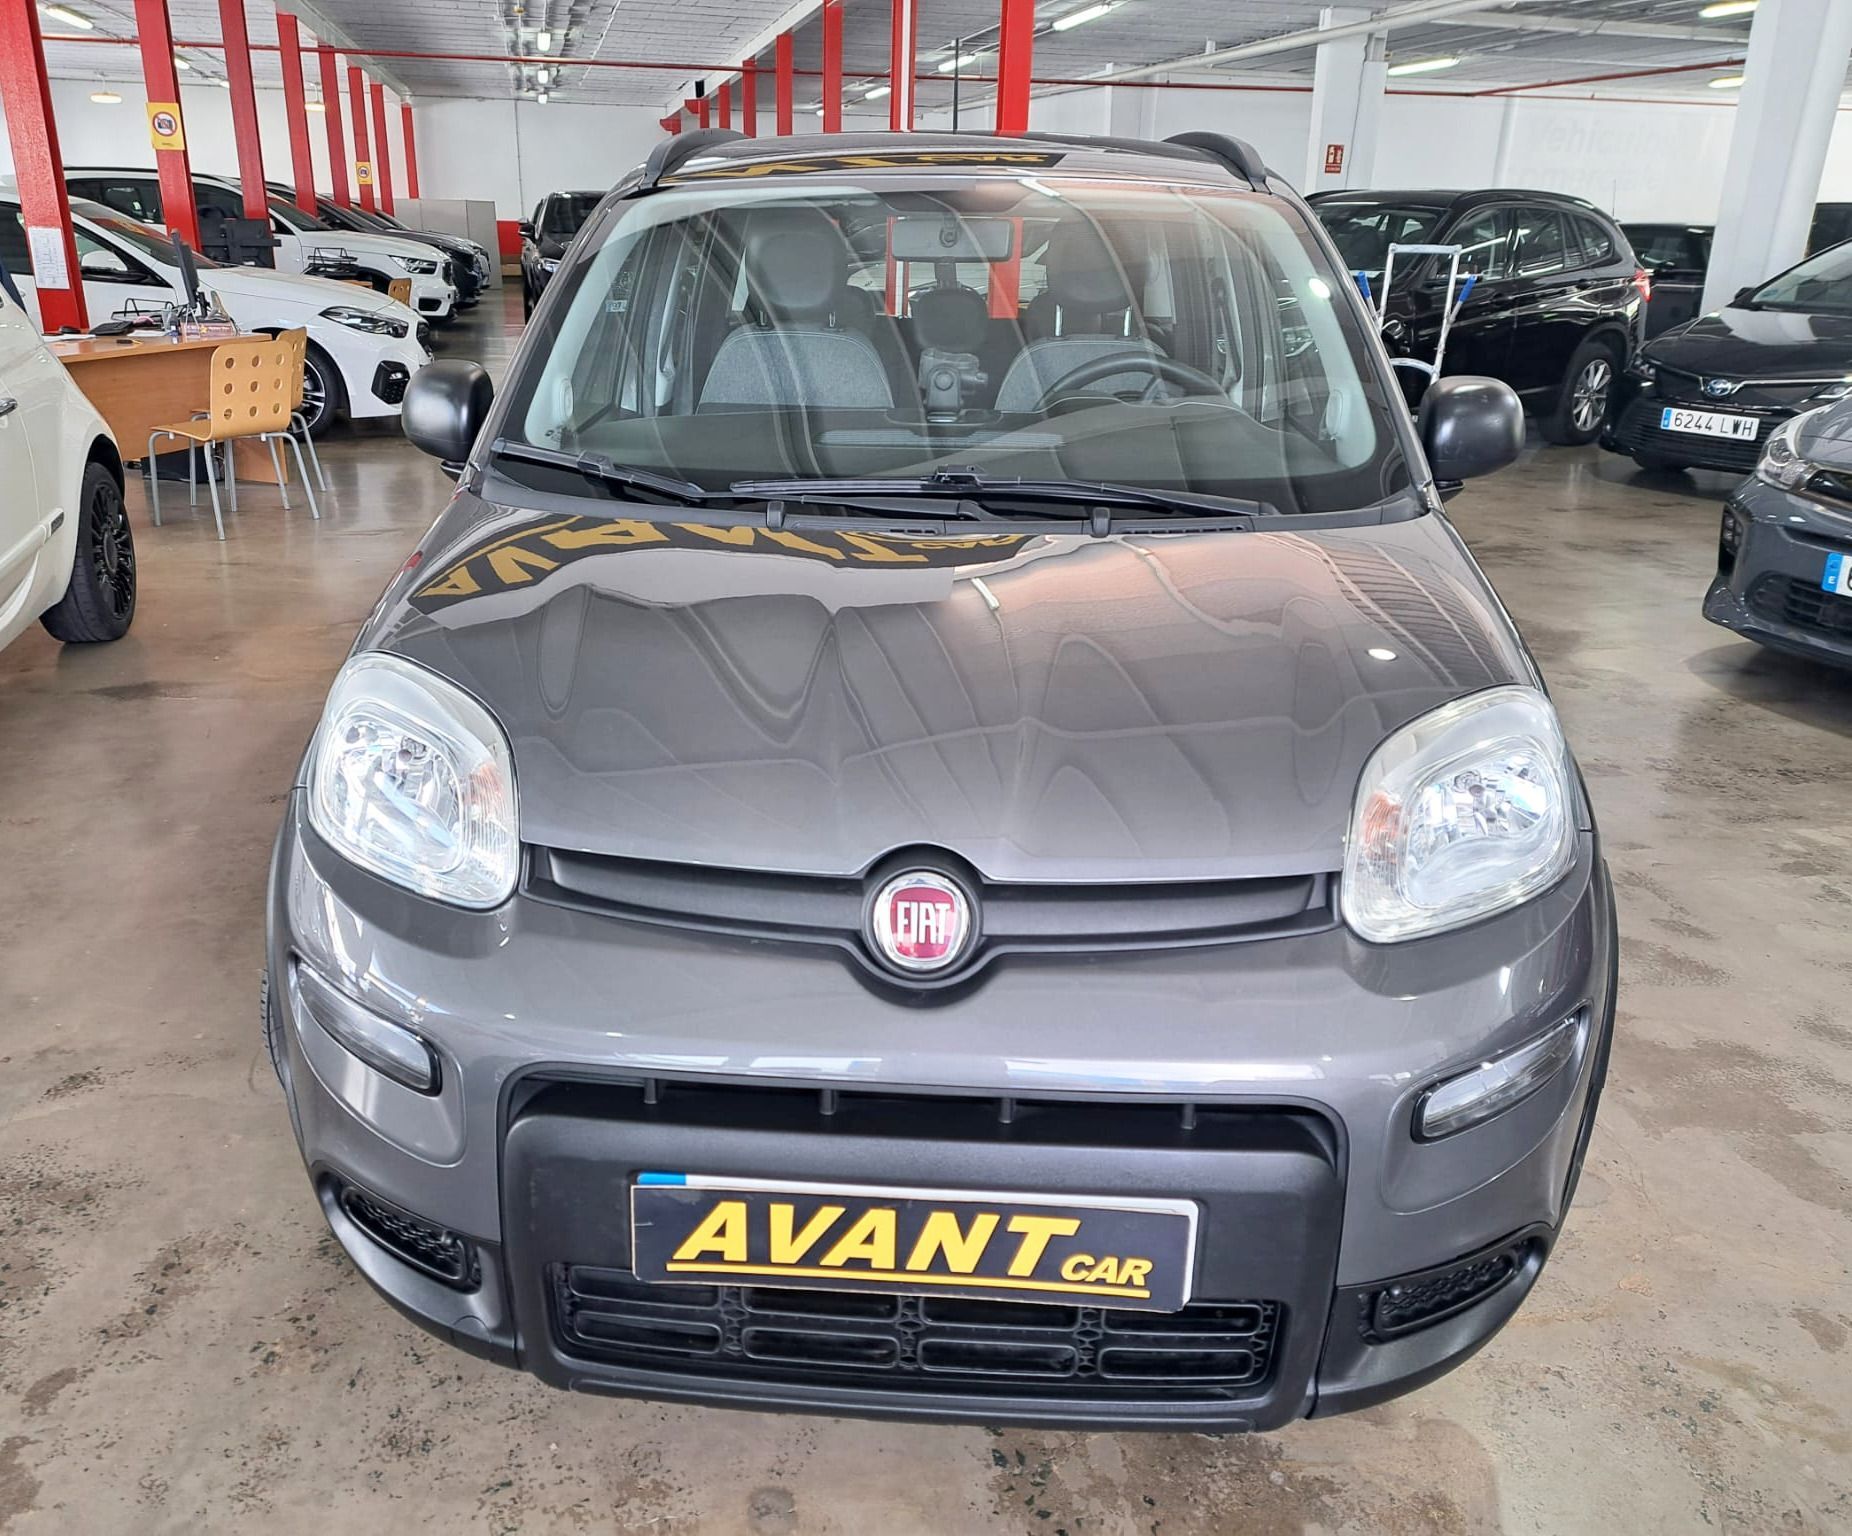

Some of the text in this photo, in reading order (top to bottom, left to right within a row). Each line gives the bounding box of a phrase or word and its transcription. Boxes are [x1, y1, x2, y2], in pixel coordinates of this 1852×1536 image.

[1674, 412, 1713, 431] 6244
[1720, 418, 1754, 436] LWH
[896, 901, 950, 945] FIAT
[672, 1200, 1152, 1286] AVANT CAR
